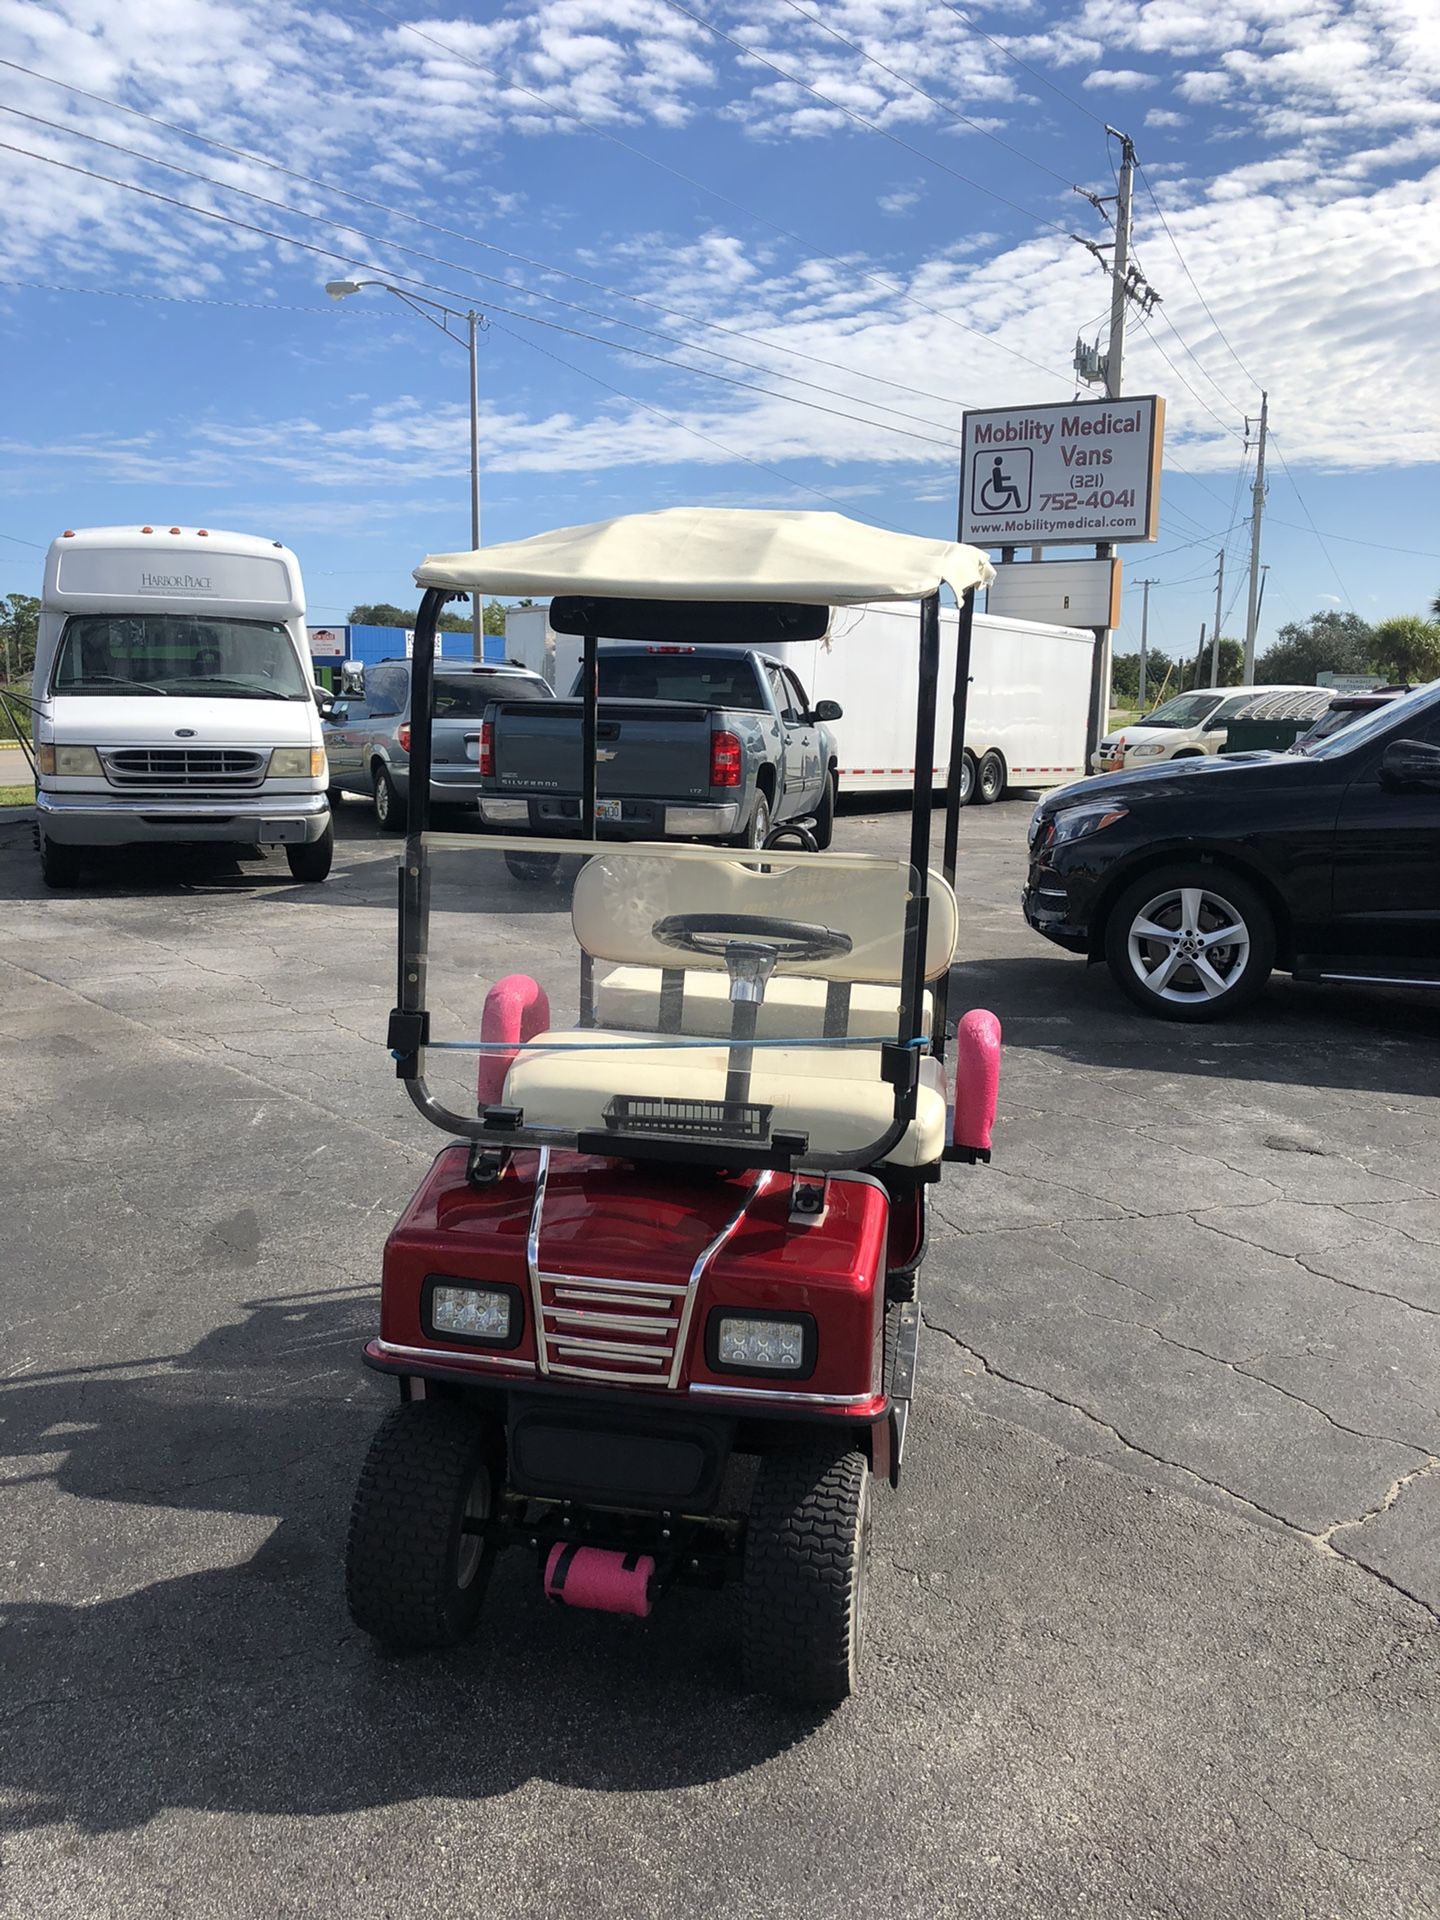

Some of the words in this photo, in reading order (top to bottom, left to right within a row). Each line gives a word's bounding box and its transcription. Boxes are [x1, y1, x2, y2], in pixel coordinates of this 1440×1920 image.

[974, 419, 1054, 445] Mobility
[1061, 410, 1141, 437] Medical
[1060, 444, 1113, 467] Vans
[1070, 473, 1104, 489] (321)
[1039, 489, 1135, 512] 752-4041
[970, 516, 1137, 533] www.Mobilitymedical.com
[142, 573, 184, 587] HARBOR
[185, 575, 212, 588] PLACE
